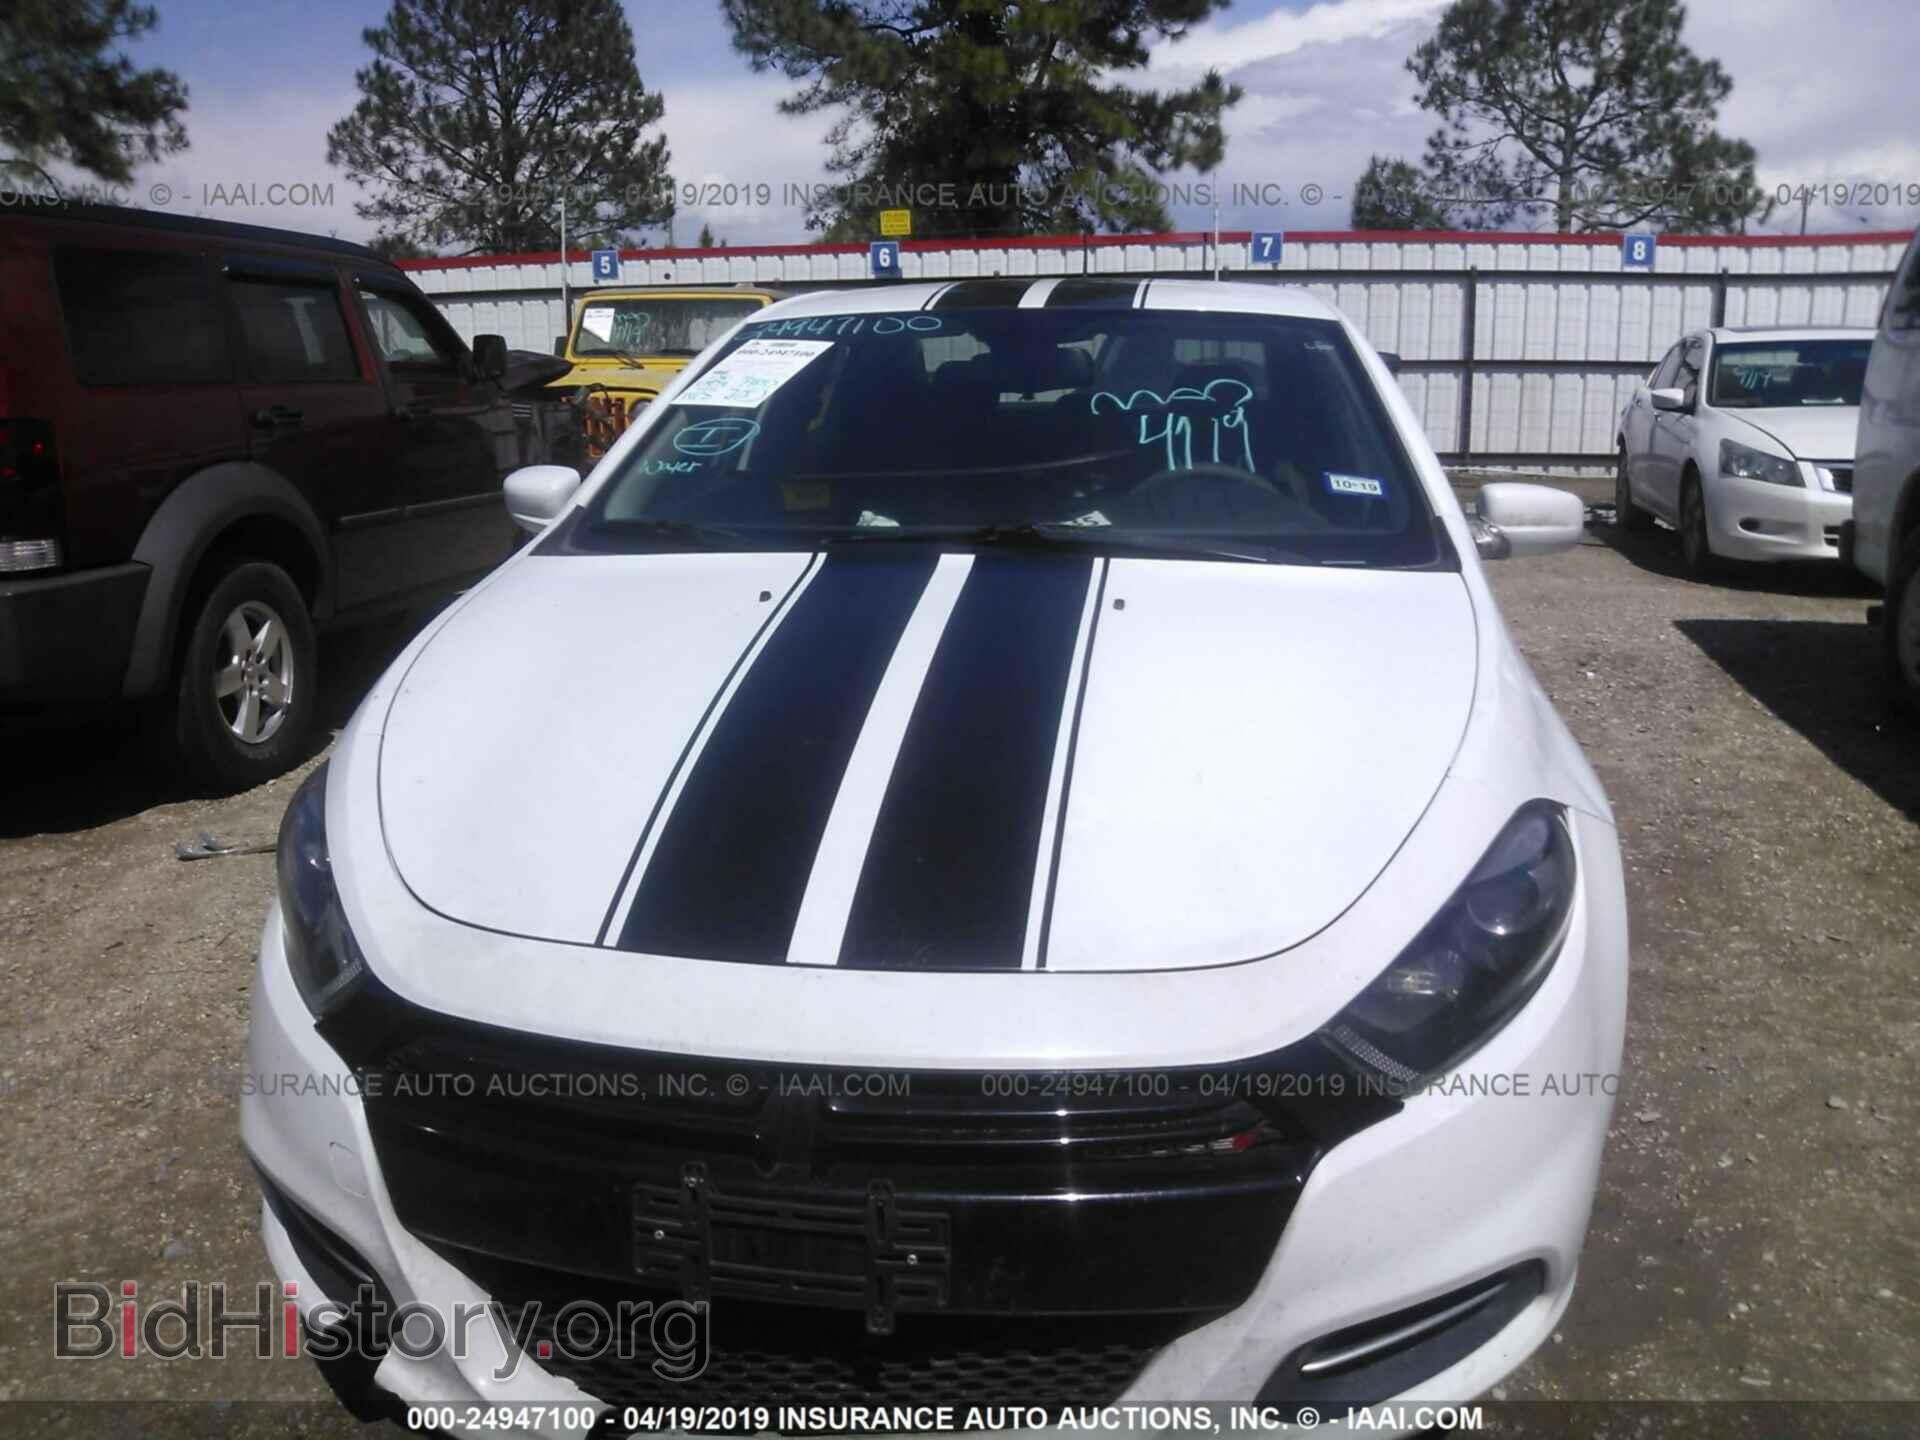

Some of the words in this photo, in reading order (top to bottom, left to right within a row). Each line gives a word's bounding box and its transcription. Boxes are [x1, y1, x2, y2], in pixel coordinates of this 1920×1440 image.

[1261, 237, 1273, 257] 7
[1633, 241, 1646, 261] 8
[600, 255, 611, 274] 5
[879, 247, 891, 268] 6
[1333, 479, 1379, 492] 10-19
